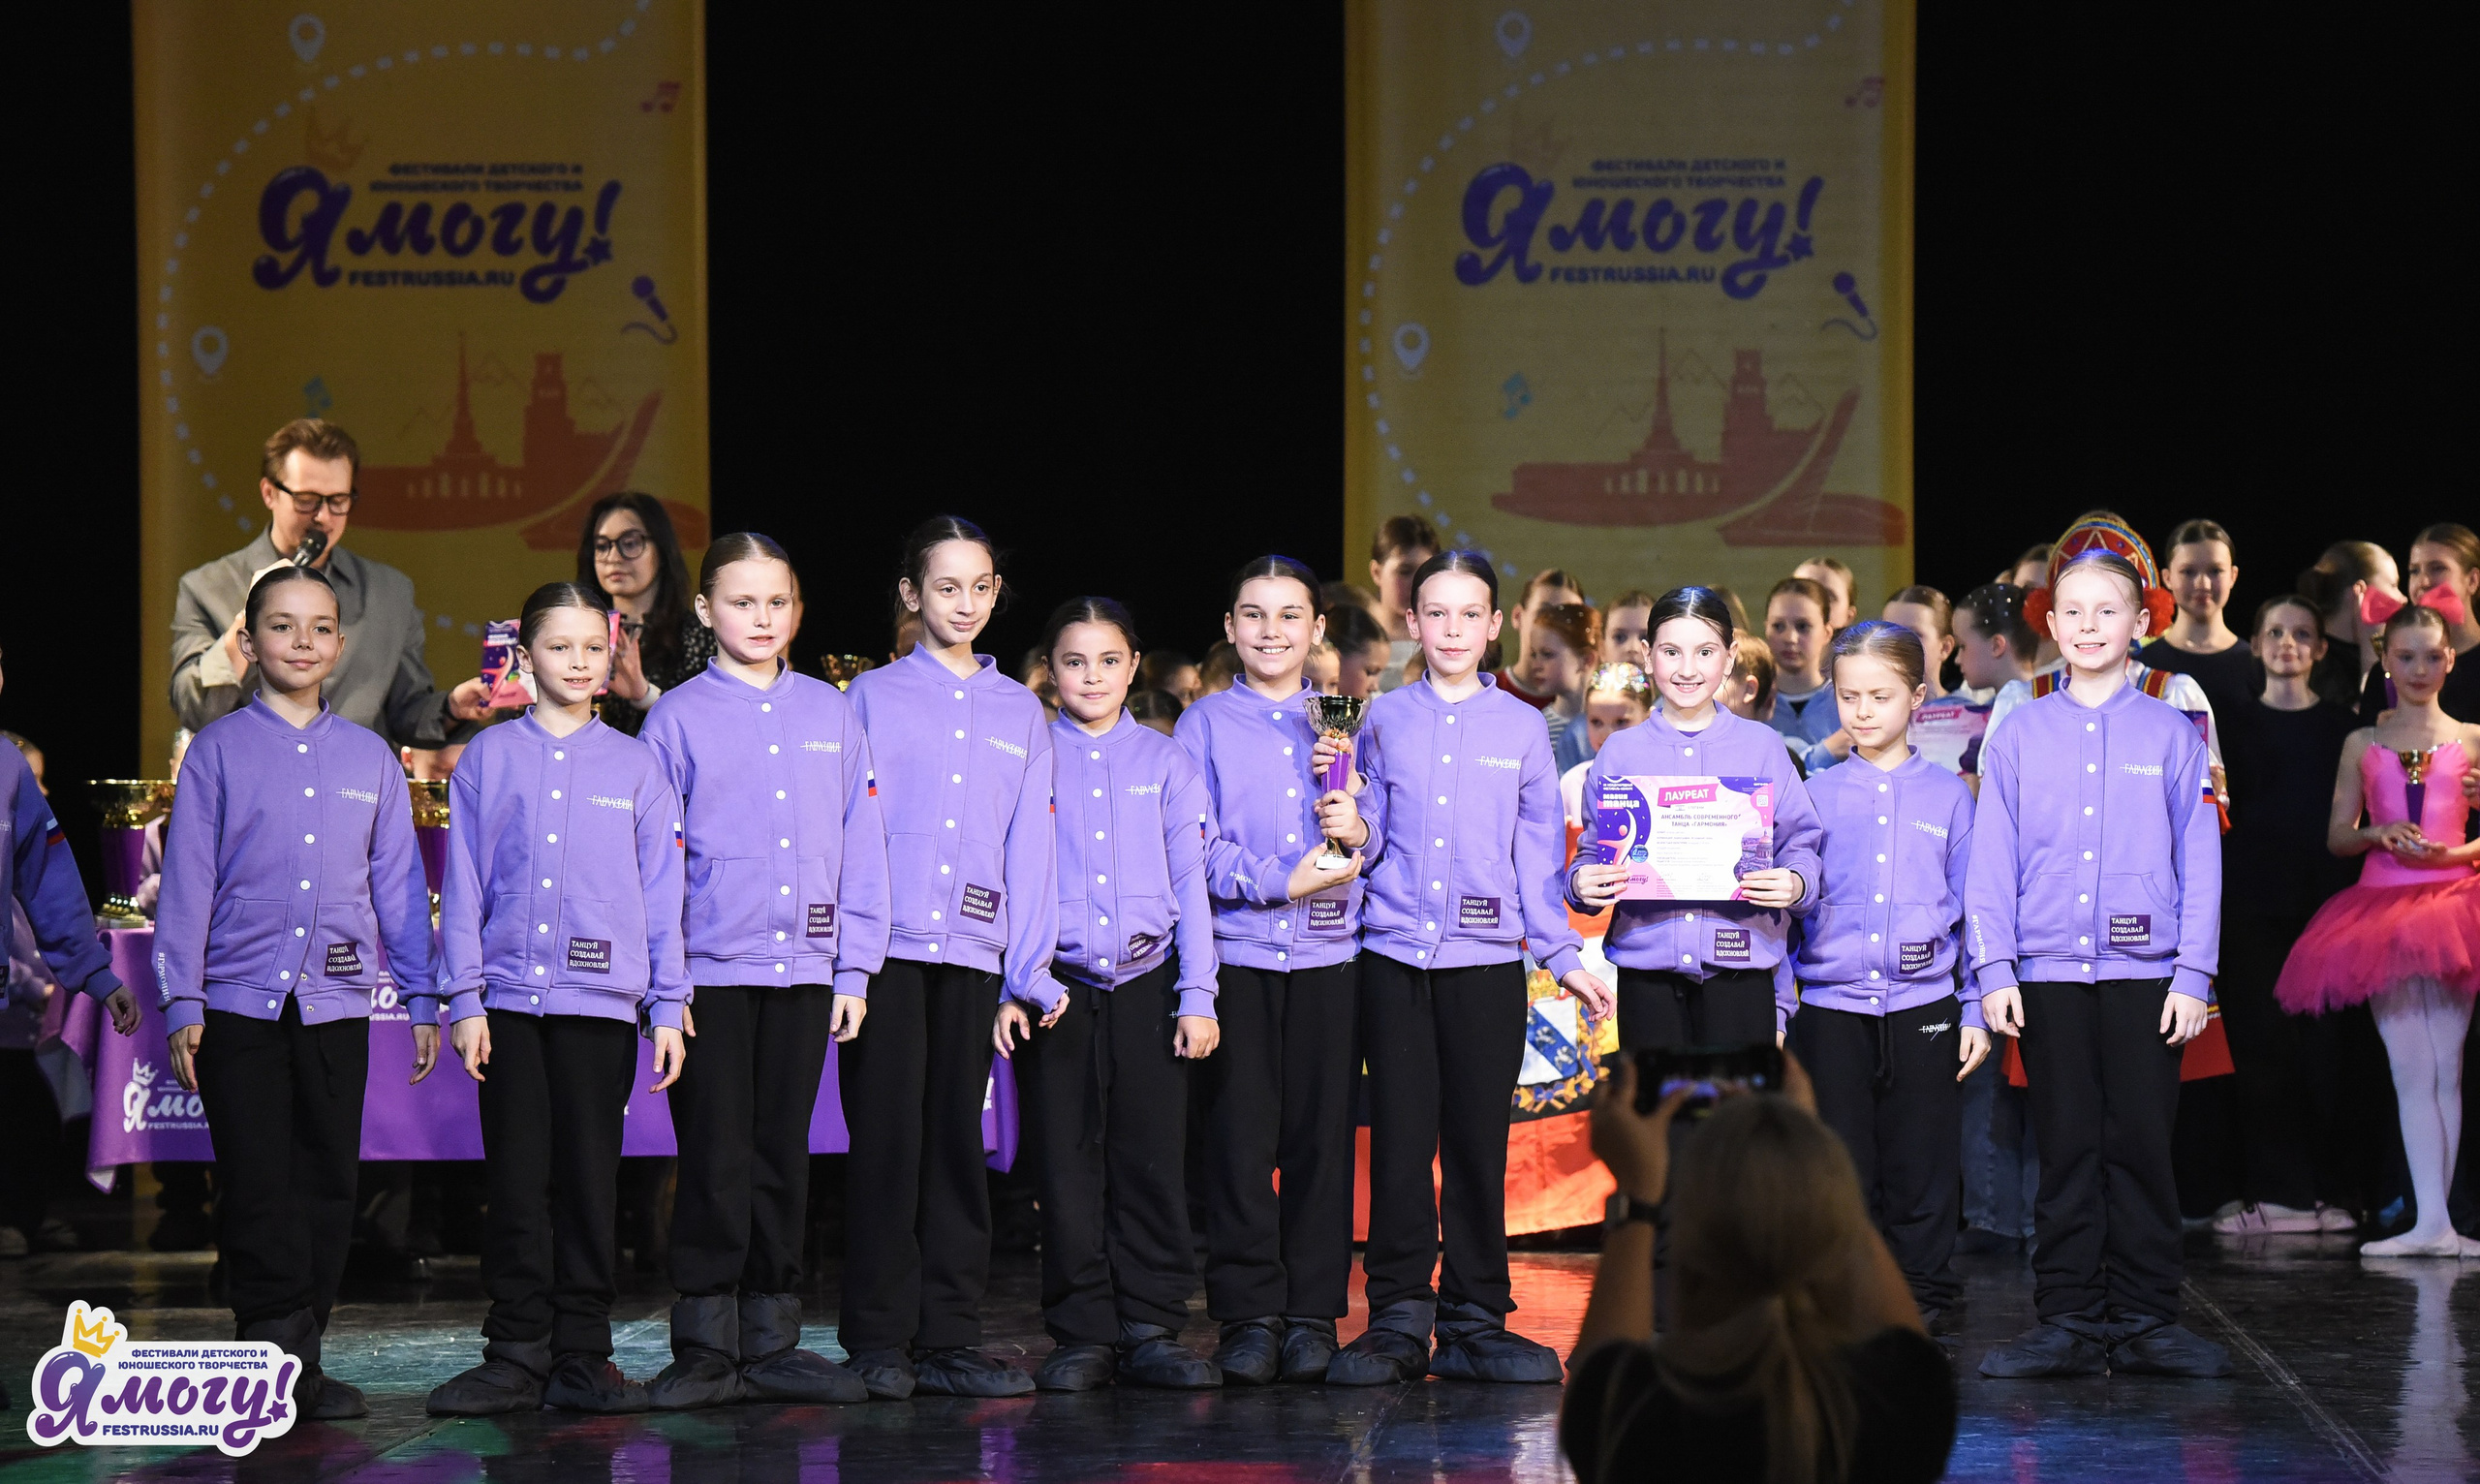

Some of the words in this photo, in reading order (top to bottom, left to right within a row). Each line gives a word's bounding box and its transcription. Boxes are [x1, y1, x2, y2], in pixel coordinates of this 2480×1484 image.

[389, 164, 484, 175] ФЕСТИВАЛИ
[487, 164, 568, 176] ДЕТСКОГО
[573, 164, 583, 175] И
[1592, 159, 1688, 171] ФЕСТИВАЛИ
[1690, 159, 1770, 172] ДЕТСКОГО
[1776, 160, 1785, 171] И
[369, 179, 480, 193] ЮНОШЕСКОГО
[483, 179, 583, 192] ТВОРЧЕСТВА
[1571, 176, 1683, 189] ЮНОШЕСКОГО
[1686, 176, 1785, 188] ТВОРЧЕСТВА
[349, 269, 515, 287] FESTRUSSIA.RU
[1550, 265, 1718, 283] FESTRUSSIA.RU
[1664, 788, 1710, 802] ЛАУРЕАТ
[1311, 910, 1341, 918] СОЗДАВАЙ
[2111, 916, 2137, 925] ТАНЦУЙ
[2111, 925, 2144, 934] СОЗДАВАЙ
[572, 940, 598, 949] ТАНЦУЙ
[1901, 943, 1927, 952] ТАНЦУЙ
[570, 949, 604, 959] СОЗДАВАЙ
[569, 959, 609, 970] ВДОХНОВЛЯЙ
